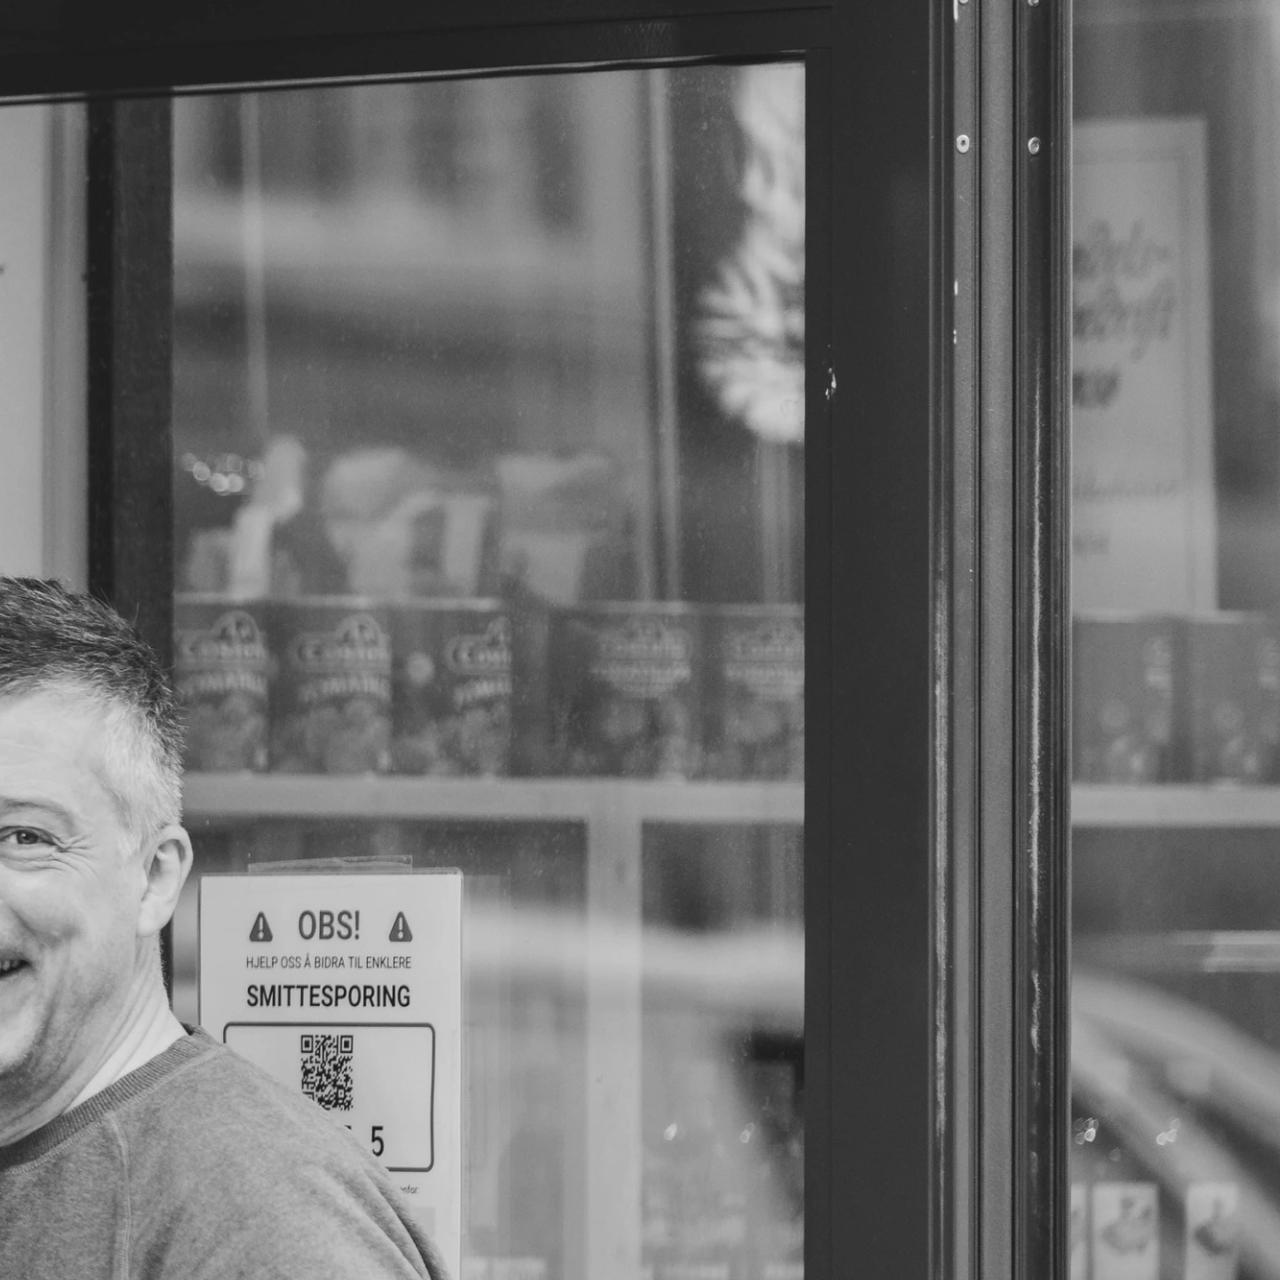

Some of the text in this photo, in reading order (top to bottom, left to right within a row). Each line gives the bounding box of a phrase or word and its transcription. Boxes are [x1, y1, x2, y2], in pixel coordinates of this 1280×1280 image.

[298, 909, 360, 940] OBS!
[246, 953, 412, 969] HJELP OSS Å BIDRA TIL ENKLERE
[246, 984, 411, 1008] SMITTESPORING
[371, 1126, 385, 1157] 5
